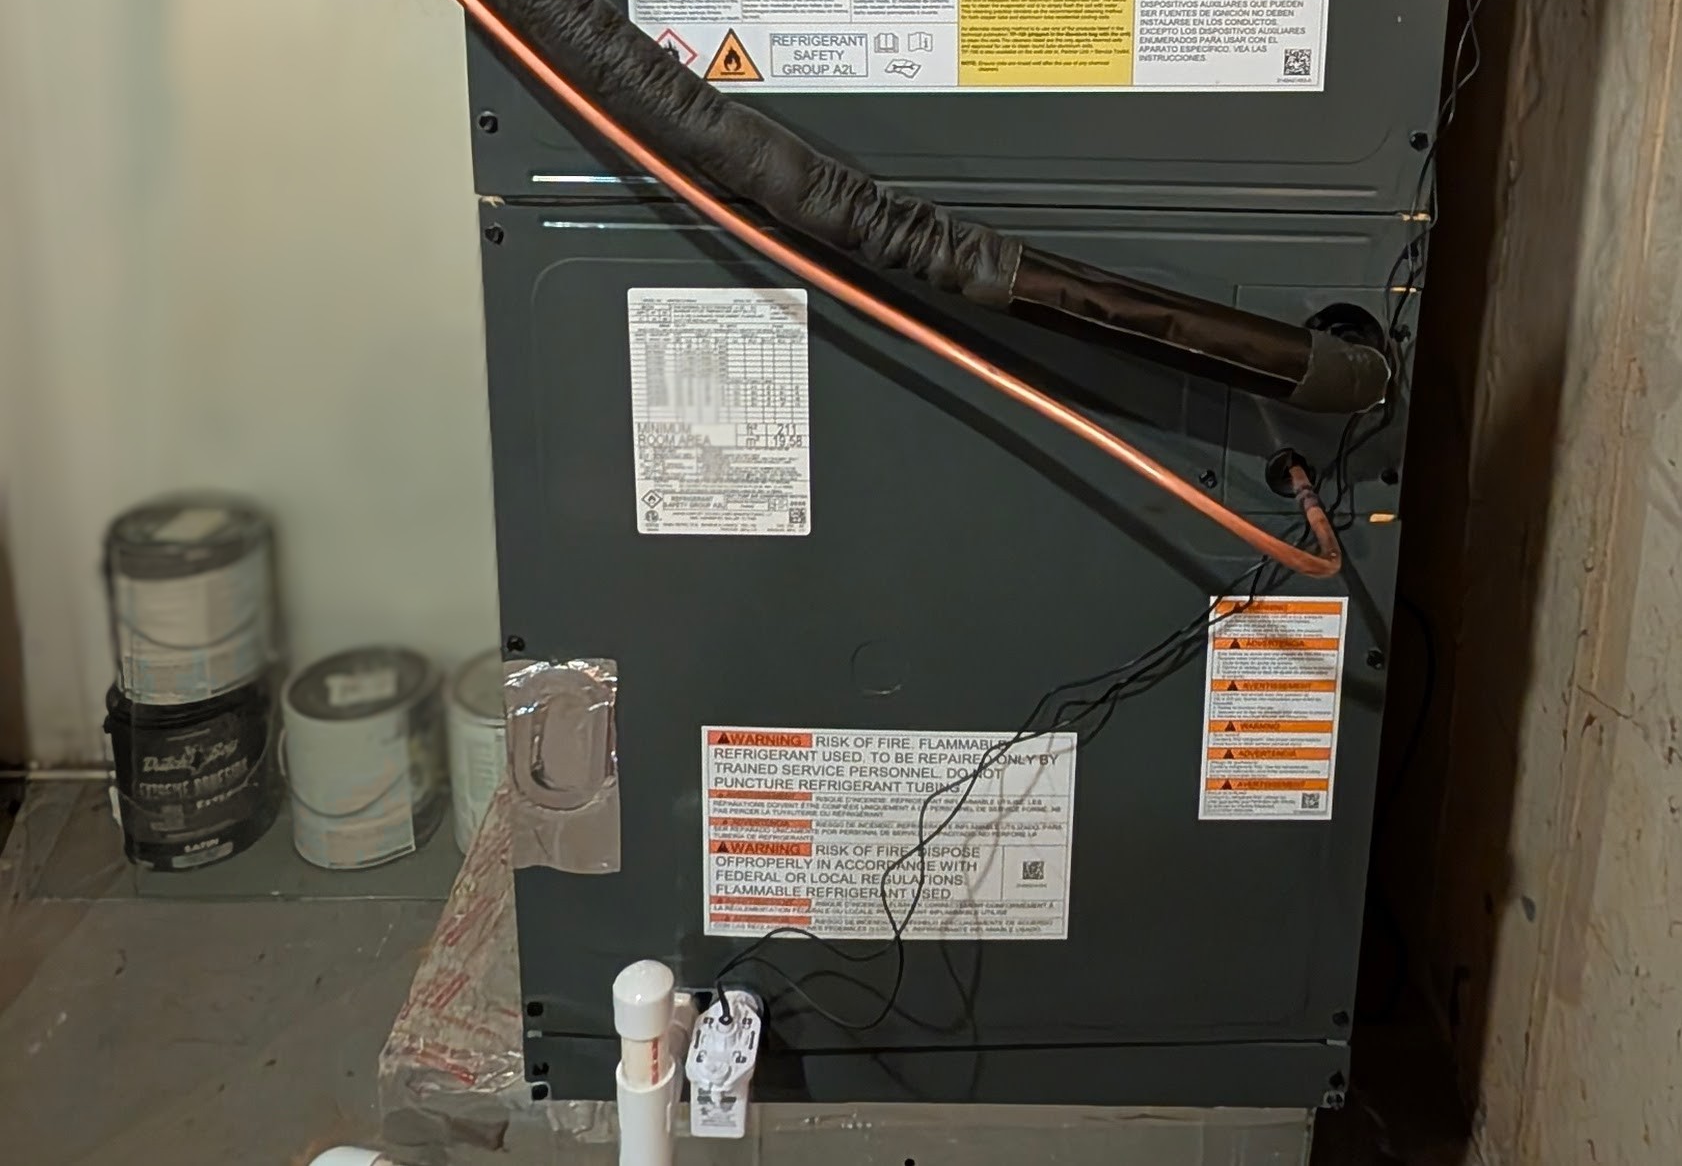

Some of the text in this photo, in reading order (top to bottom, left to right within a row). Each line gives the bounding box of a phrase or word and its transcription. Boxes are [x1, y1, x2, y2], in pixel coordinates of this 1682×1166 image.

[772, 35, 863, 46] REFRIGERANT
[794, 50, 844, 61] SAFETY
[782, 64, 856, 75] GROUP A2L
[730, 734, 802, 746] WARNING
[815, 736, 848, 747] RISK
[853, 737, 872, 747] OF
[714, 748, 816, 760] REFRIGERANT
[870, 751, 890, 762] TO
[894, 751, 913, 762] BE
[997, 753, 1037, 765] ONLY
[1039, 754, 1059, 765] BY
[715, 762, 777, 775] TRAINED
[781, 764, 844, 776] SERVICE
[947, 767, 968, 779] DO
[714, 777, 793, 790] PUNCTURE
[798, 779, 902, 792] REFRIGERANT
[731, 843, 800, 855] WARNING
[815, 844, 847, 855] RISK
[852, 845, 871, 856] OF
[816, 858, 831, 869] IN
[939, 860, 977, 872] WITH
[716, 871, 779, 882] FEDERAL
[784, 872, 806, 882] OR
[810, 872, 857, 883] LOCAL
[716, 885, 800, 896] FLAMMABLE
